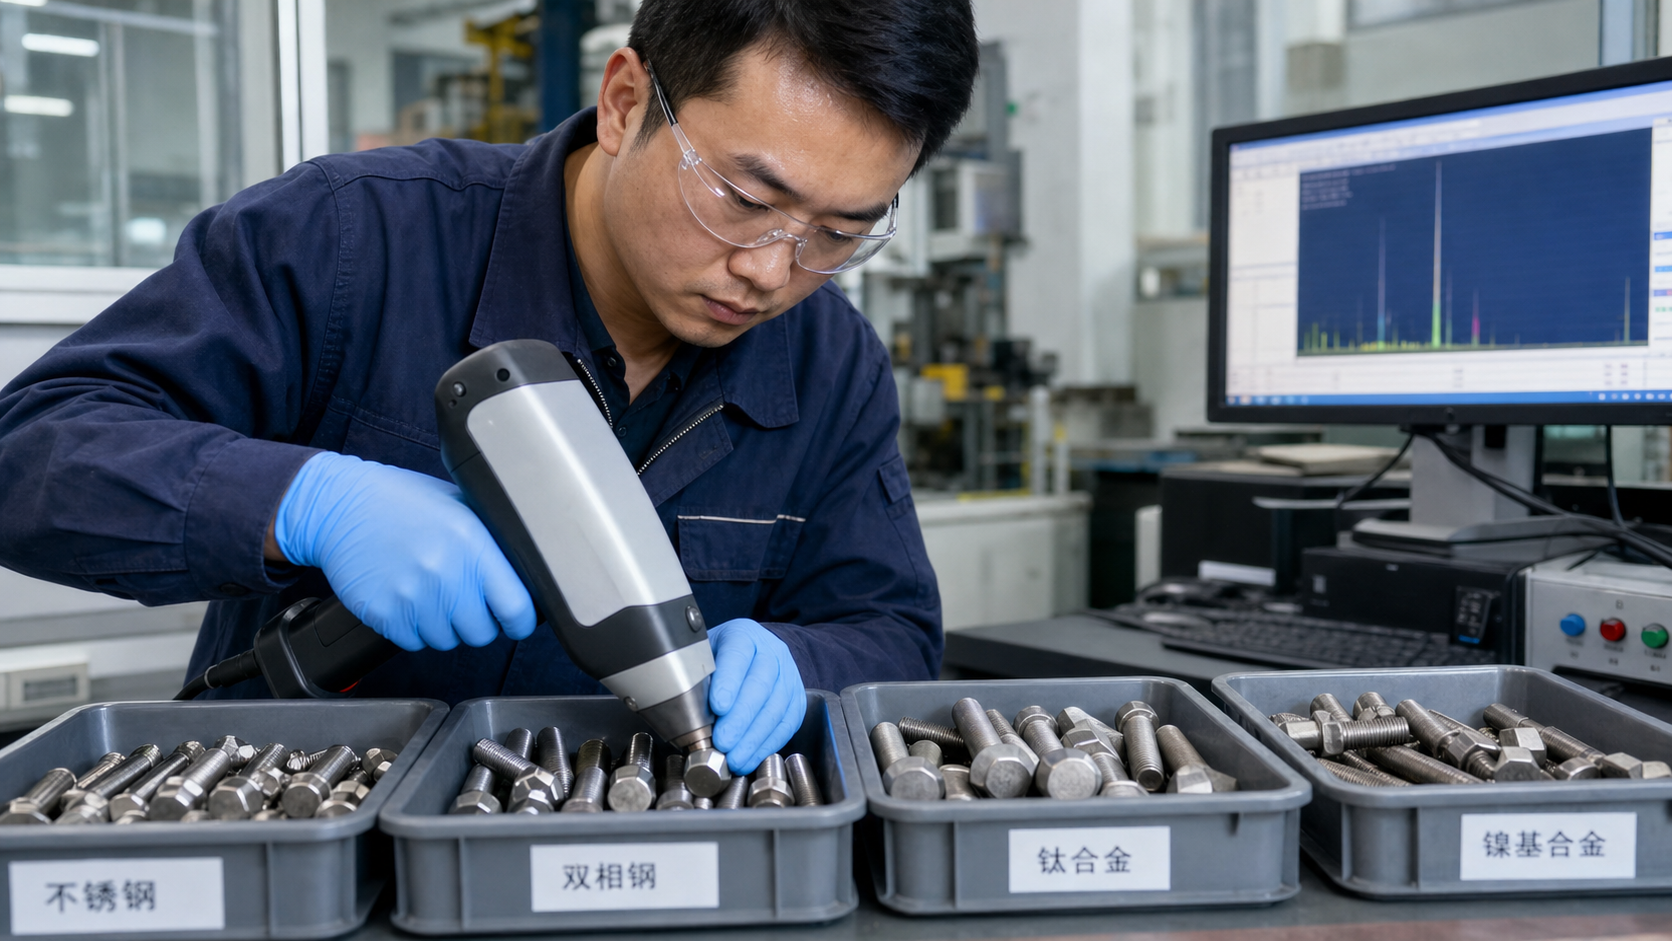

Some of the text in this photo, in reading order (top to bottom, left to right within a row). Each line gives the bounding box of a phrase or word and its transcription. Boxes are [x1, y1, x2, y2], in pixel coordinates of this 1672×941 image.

[1483, 830, 1606, 858] 镍基合金
[1038, 845, 1131, 875] 钛合金
[562, 861, 657, 891] 双相钢
[45, 879, 157, 913] 不锈钢
